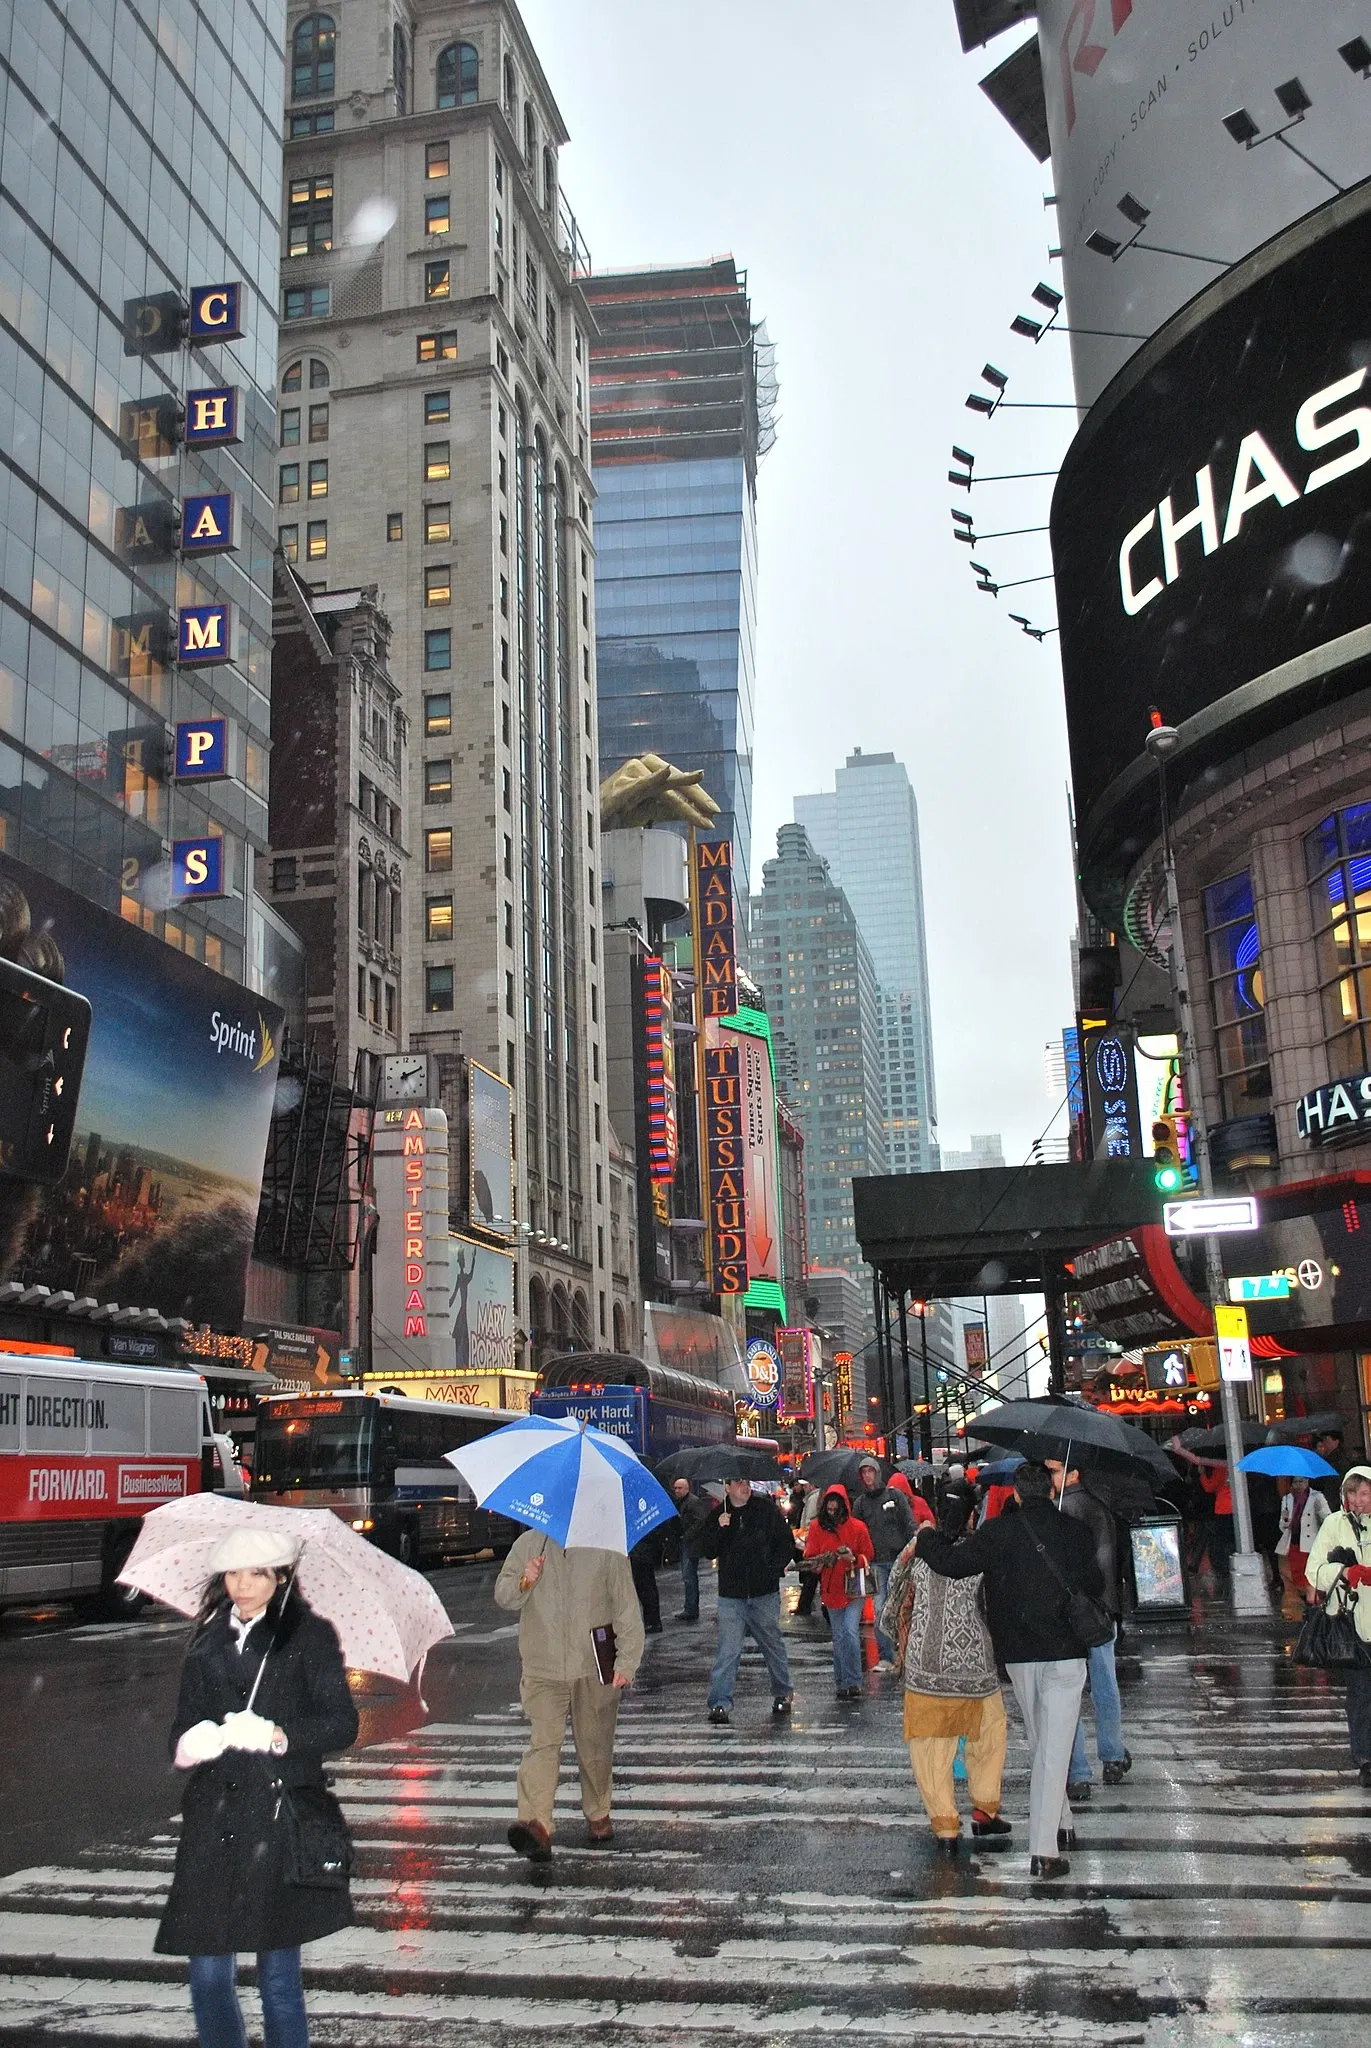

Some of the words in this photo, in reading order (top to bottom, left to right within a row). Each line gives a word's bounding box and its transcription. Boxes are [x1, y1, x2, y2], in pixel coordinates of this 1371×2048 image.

[1129, 75, 1168, 132] SCAN
[1187, 0, 1268, 62] SOLUT
[1118, 367, 1371, 616] CHAS
[184, 292, 228, 886] CHAMPS
[700, 842, 732, 1016] MADAME
[209, 1011, 256, 1060] Sprint
[746, 1042, 755, 1100] Square
[753, 1050, 762, 1101] Here!
[39, 1077, 52, 1115] Sprint
[385, 1110, 404, 1122] NEW
[1296, 1076, 1371, 1139] CHAS
[748, 1103, 758, 1149] Times
[755, 1105, 765, 1146] Starts
[710, 1047, 742, 1292] TUSSAUD'S
[403, 1109, 426, 1338] AMSTERDAM
[476, 1300, 507, 1339] MARY
[112, 1337, 128, 1350] Van
[128, 1338, 156, 1354] Wagner
[469, 1331, 514, 1369] POPPINS
[591, 1388, 605, 1397] 837
[747, 1363, 779, 1384] D&B
[26, 1395, 109, 1429] DIRECTION.
[211, 1395, 217, 1407] S
[566, 1405, 598, 1418] Work
[601, 1405, 634, 1418] Hard.
[29, 1469, 109, 1501] FORWARD.
[123, 1474, 183, 1494] BusinessWeek
